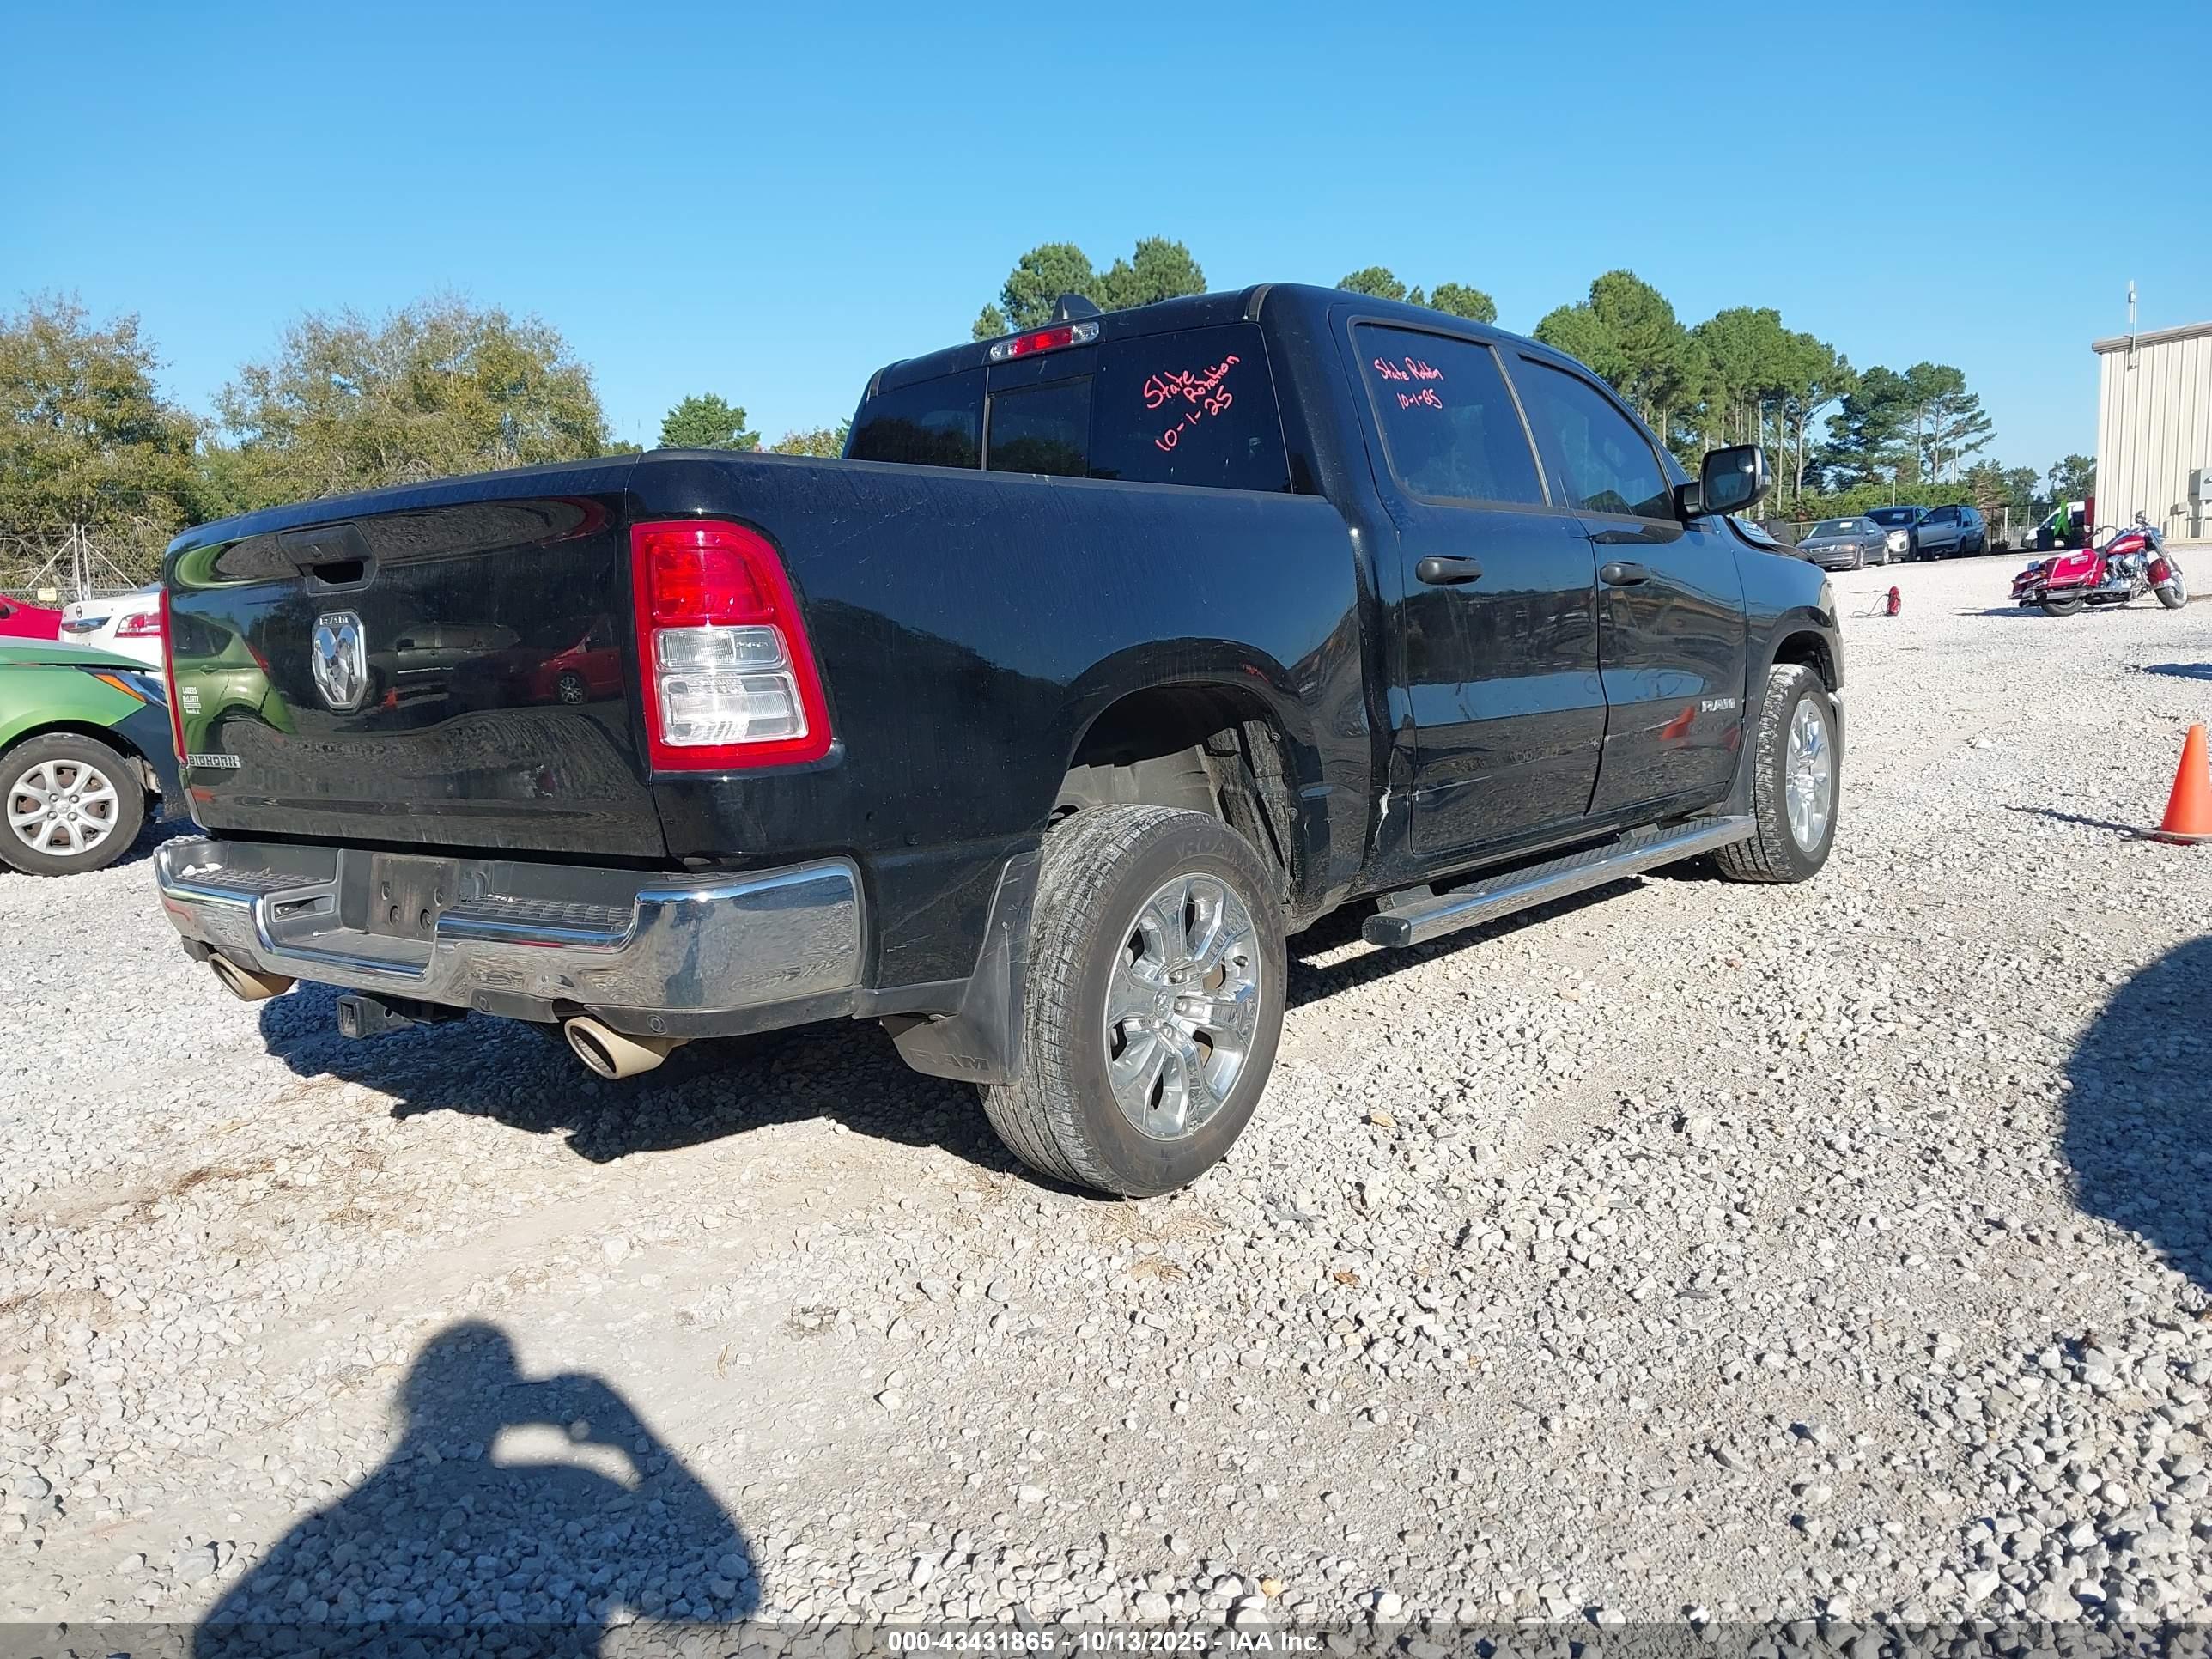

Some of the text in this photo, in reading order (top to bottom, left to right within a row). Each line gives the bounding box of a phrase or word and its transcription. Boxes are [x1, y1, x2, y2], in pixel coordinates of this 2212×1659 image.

[1143, 369, 1195, 409] State
[1155, 385, 1233, 452] 10-1-25
[1701, 697, 1735, 713] RAM
[908, 1047, 990, 1071] RAM
